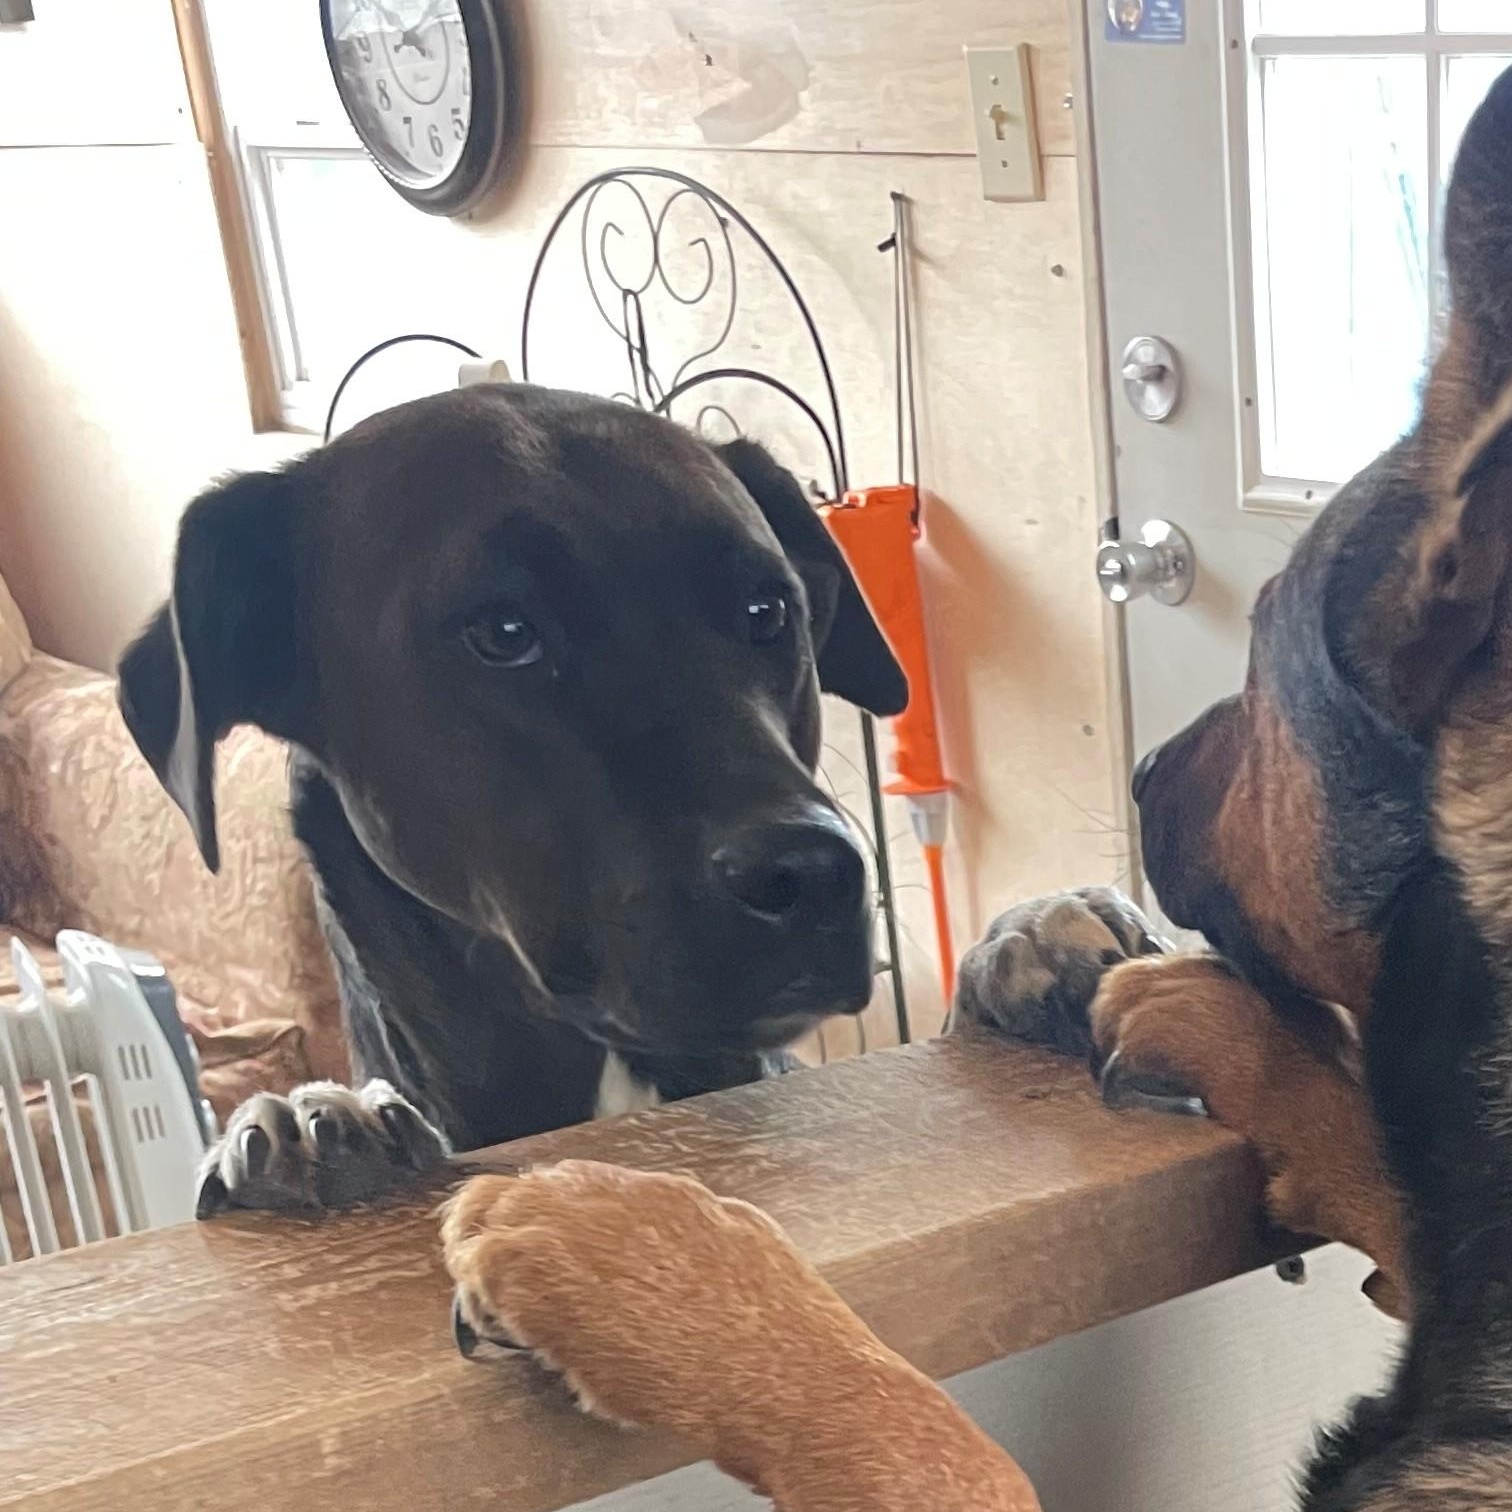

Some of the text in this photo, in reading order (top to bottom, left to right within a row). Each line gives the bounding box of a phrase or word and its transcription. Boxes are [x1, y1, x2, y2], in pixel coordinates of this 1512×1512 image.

[376, 78, 392, 112] 8
[402, 116, 415, 149] 7
[428, 123, 444, 158] 6
[450, 107, 465, 141] 5
